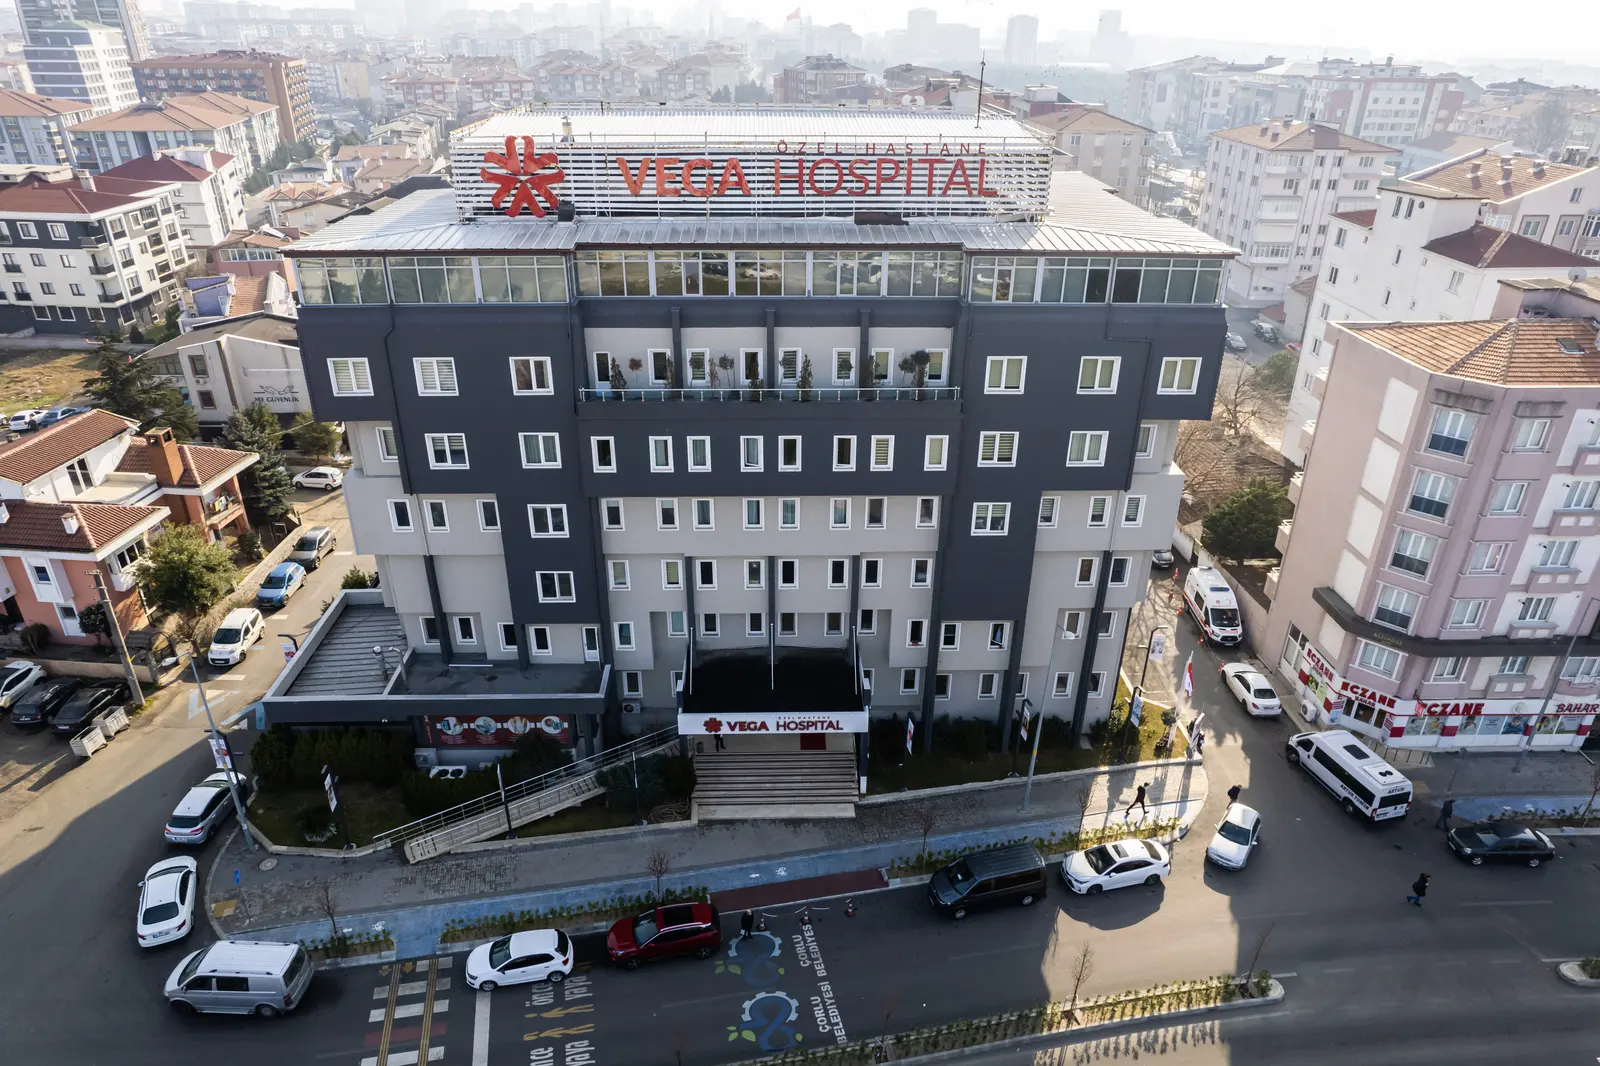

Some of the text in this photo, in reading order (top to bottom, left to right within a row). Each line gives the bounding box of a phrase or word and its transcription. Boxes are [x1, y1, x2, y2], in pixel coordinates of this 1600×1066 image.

[777, 139, 986, 154] ÖZEL HASTANE
[615, 157, 998, 197] VEGA HOSPITAL
[1306, 648, 1334, 682] ECZANE
[1341, 681, 1397, 709] ECZANE
[1556, 703, 1600, 713] BAHAR
[726, 720, 843, 732] VEGA HOSPITAL
[792, 934, 812, 967] ÇORLU
[802, 923, 827, 977] BELEDİYES
[525, 981, 554, 1007] önce
[564, 975, 593, 1001] yaya
[810, 996, 832, 1033] ÇORLU
[817, 981, 848, 1047] BELEDİYESİ
[565, 1040, 596, 1066] yaya
